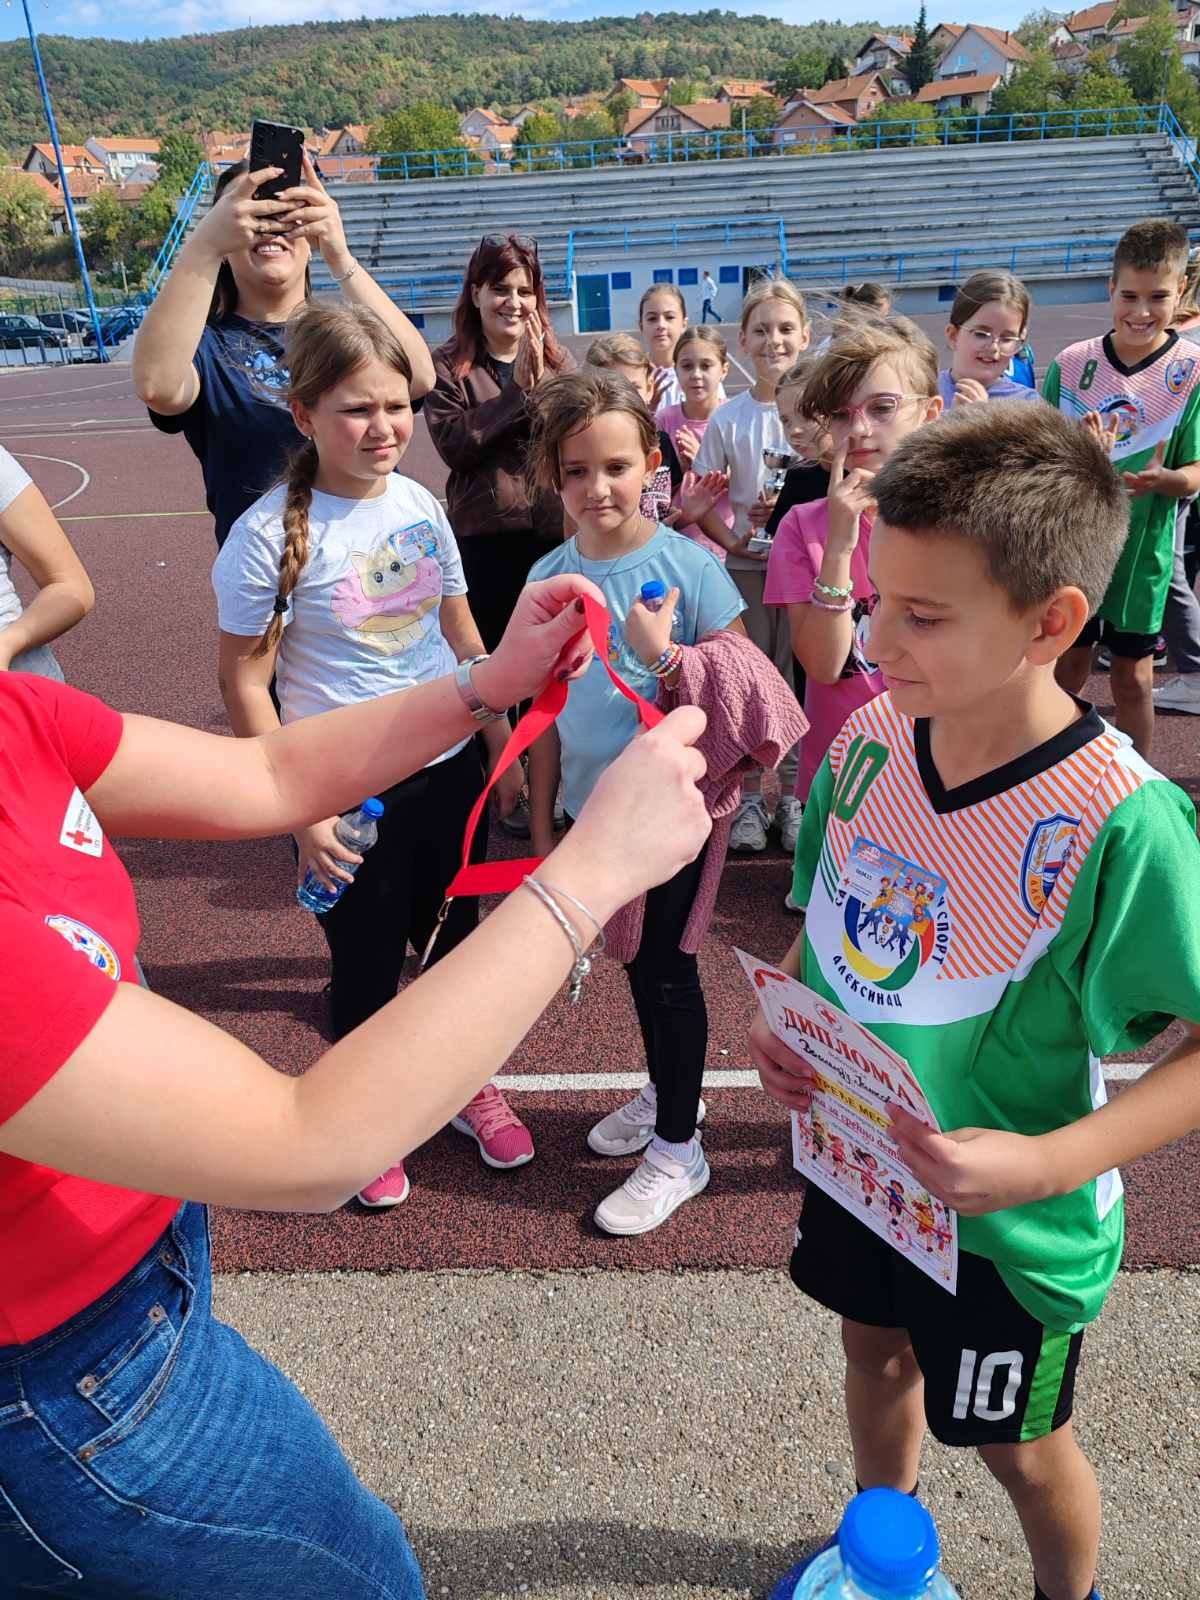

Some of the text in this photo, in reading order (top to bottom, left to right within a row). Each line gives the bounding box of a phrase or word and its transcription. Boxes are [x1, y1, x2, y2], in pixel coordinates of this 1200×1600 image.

[1079, 359, 1098, 390] 8
[932, 911, 950, 965] СПОРТ
[832, 955, 903, 1008] АЛЕКСИНАЦ
[783, 1006, 918, 1112] ДИПЛОМА
[952, 1349, 1023, 1421] 10
